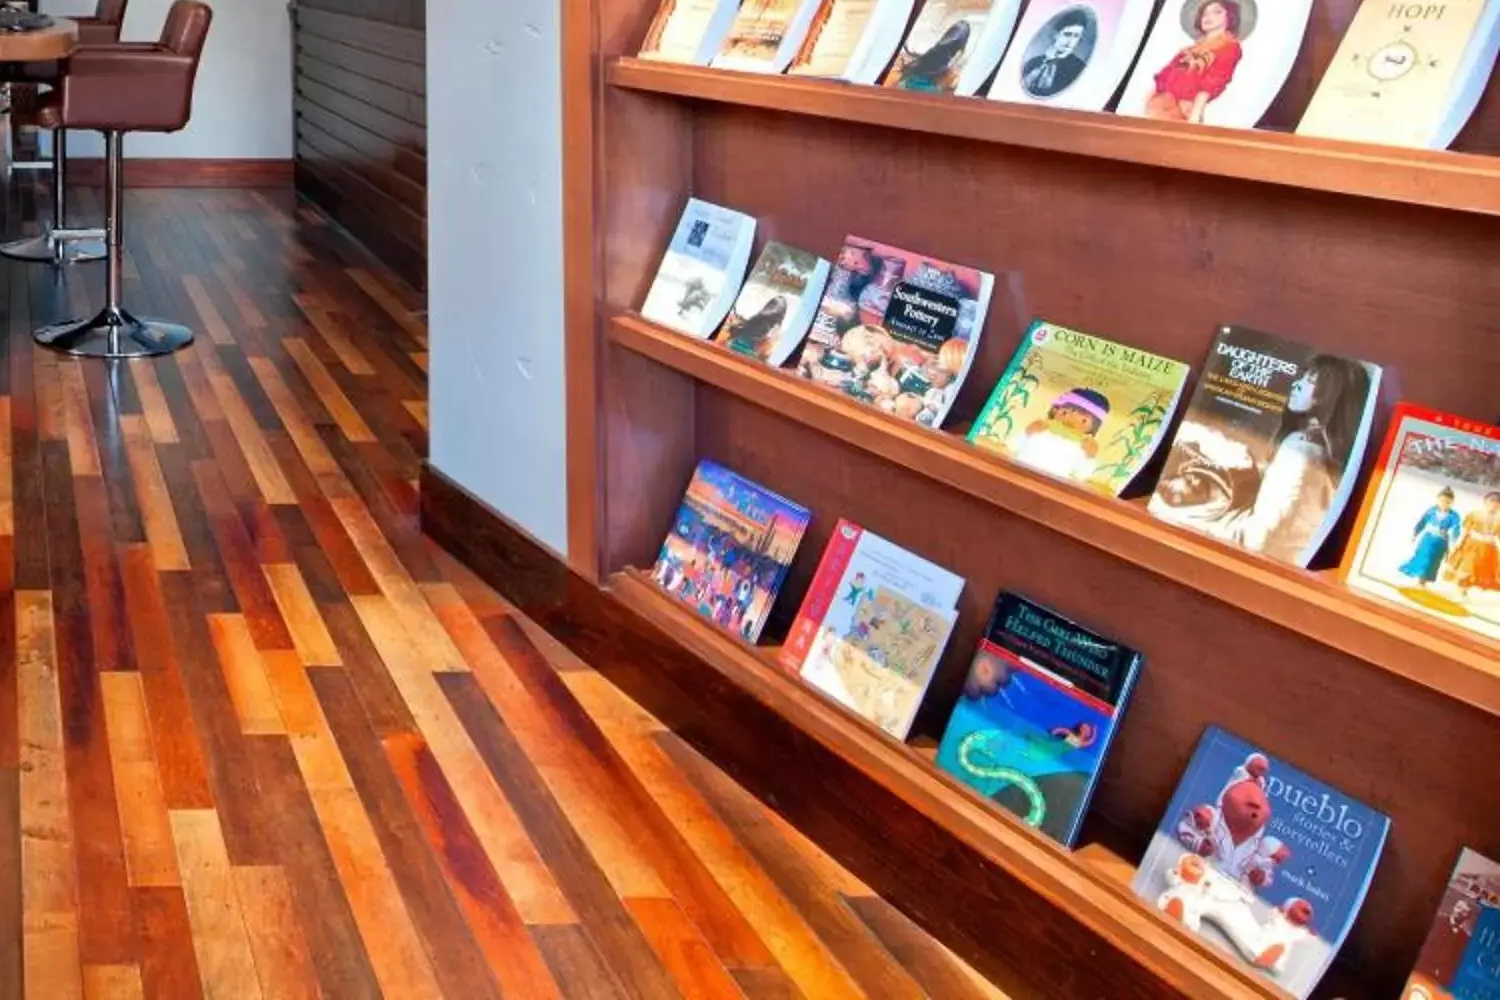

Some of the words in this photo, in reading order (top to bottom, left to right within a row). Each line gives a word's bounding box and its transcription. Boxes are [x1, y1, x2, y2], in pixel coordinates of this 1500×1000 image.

[1386, 3, 1447, 20] HOPI
[894, 284, 958, 317] Southwestern
[903, 303, 940, 328] Pottery
[1054, 329, 1097, 352] CORN
[1101, 342, 1117, 357] IS
[1120, 348, 1175, 376] MAIZE
[1216, 341, 1298, 377] DAUGHTERS
[1231, 357, 1250, 371] OF
[1228, 366, 1271, 389] EARTH
[1453, 417, 1493, 435] TRUE
[1411, 435, 1461, 455] THE
[1019, 603, 1042, 627] THE
[1004, 615, 1051, 647] HELPED
[1053, 638, 1110, 678] THUNDER
[1267, 776, 1362, 839] pueblo
[1269, 817, 1348, 868] storytellers
[1293, 811, 1337, 842] stories
[1340, 839, 1355, 852] &
